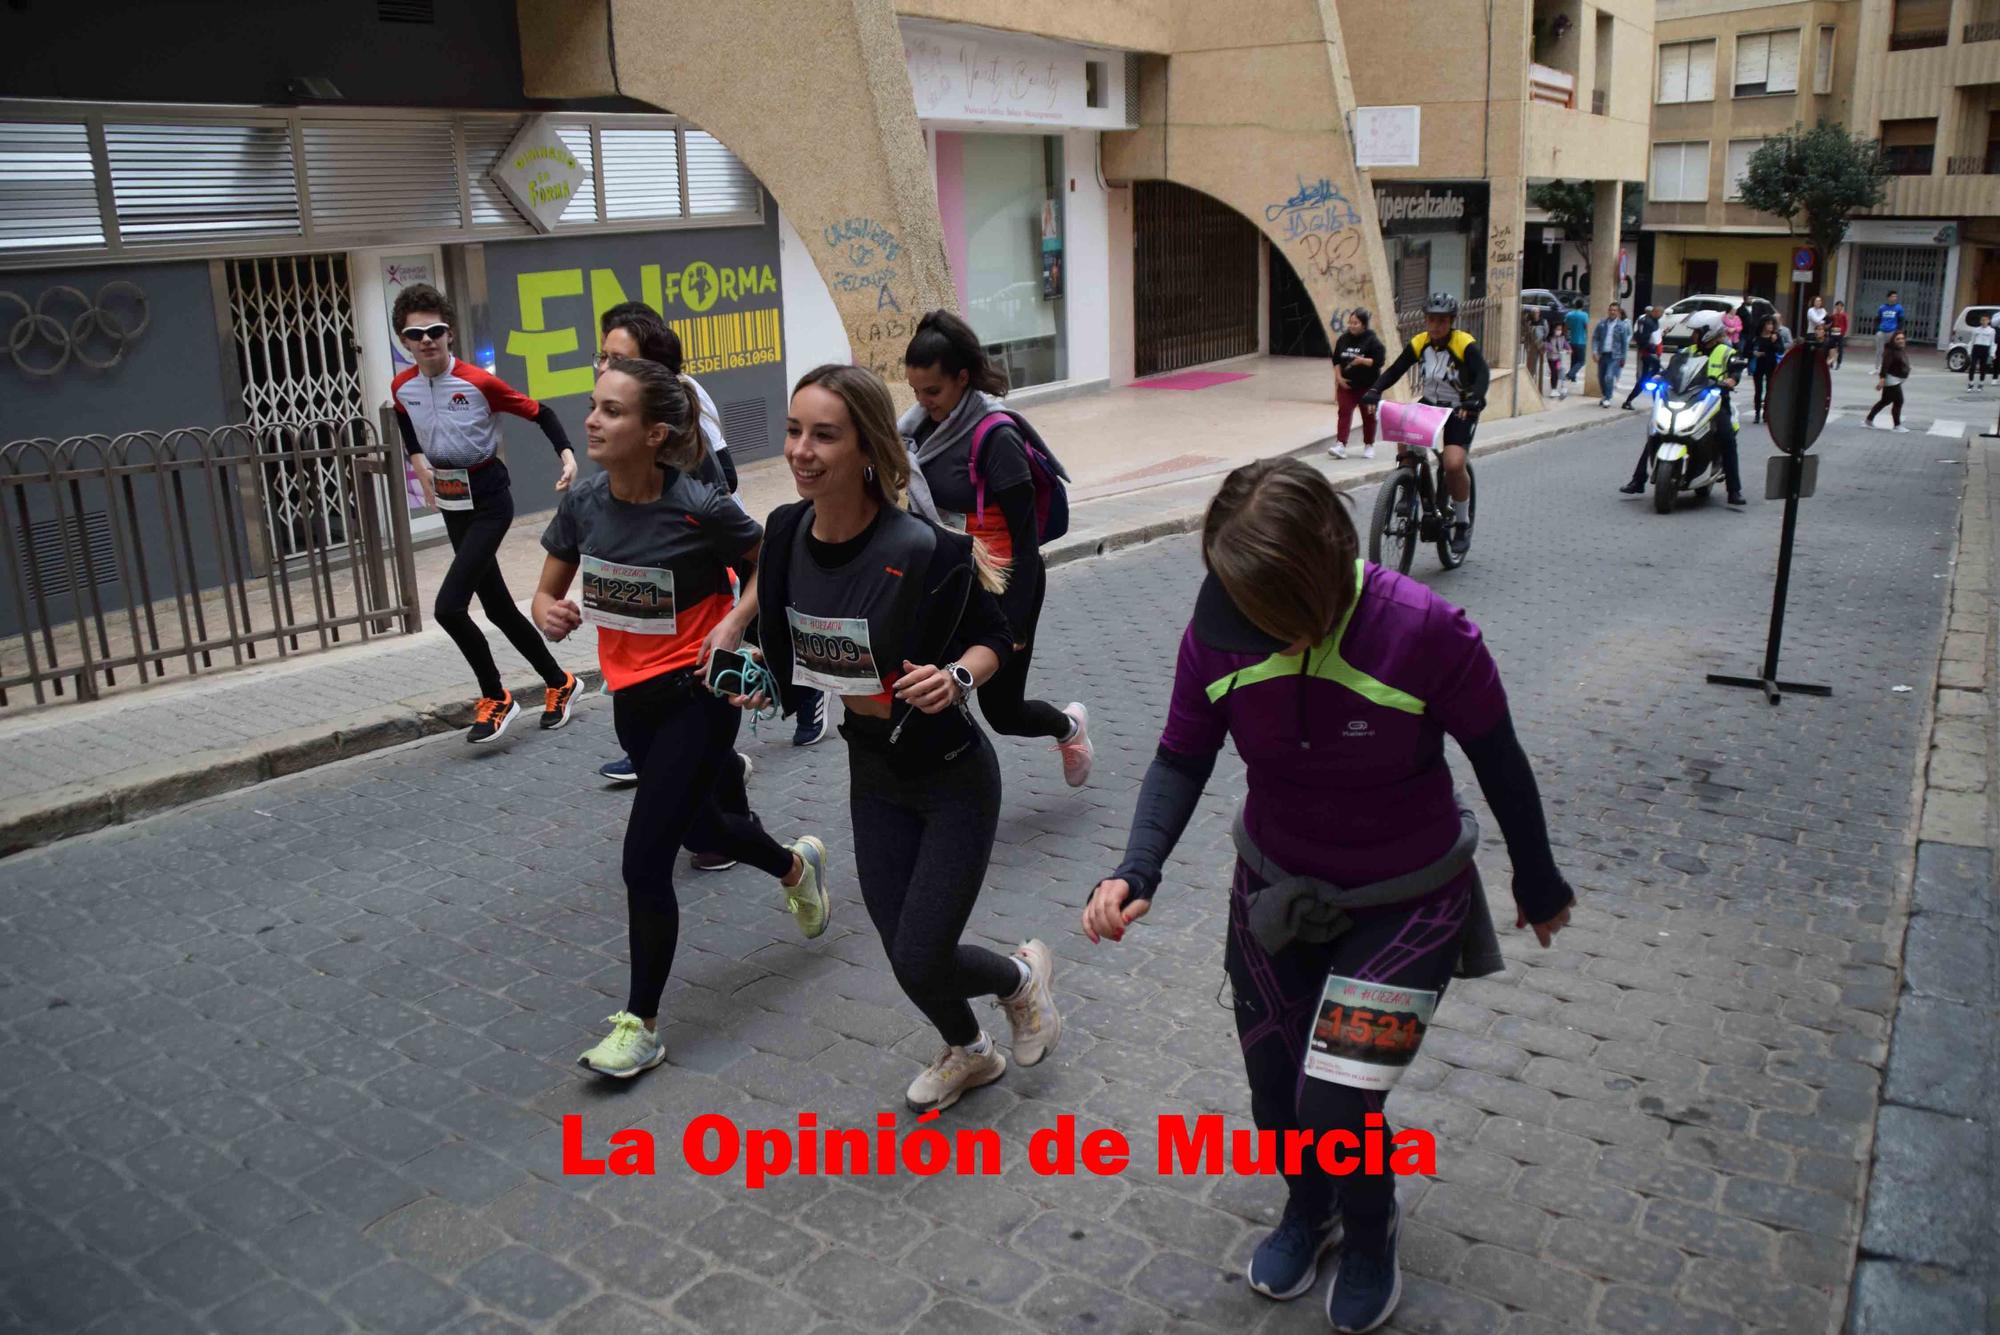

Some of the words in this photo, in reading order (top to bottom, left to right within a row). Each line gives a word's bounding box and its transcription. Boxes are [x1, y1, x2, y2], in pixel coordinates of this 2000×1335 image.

[506, 264, 664, 400] EN
[729, 350, 775, 369] 061096
[591, 576, 659, 607] 1221
[797, 631, 861, 664] 1009
[1328, 1004, 1418, 1050] 1521
